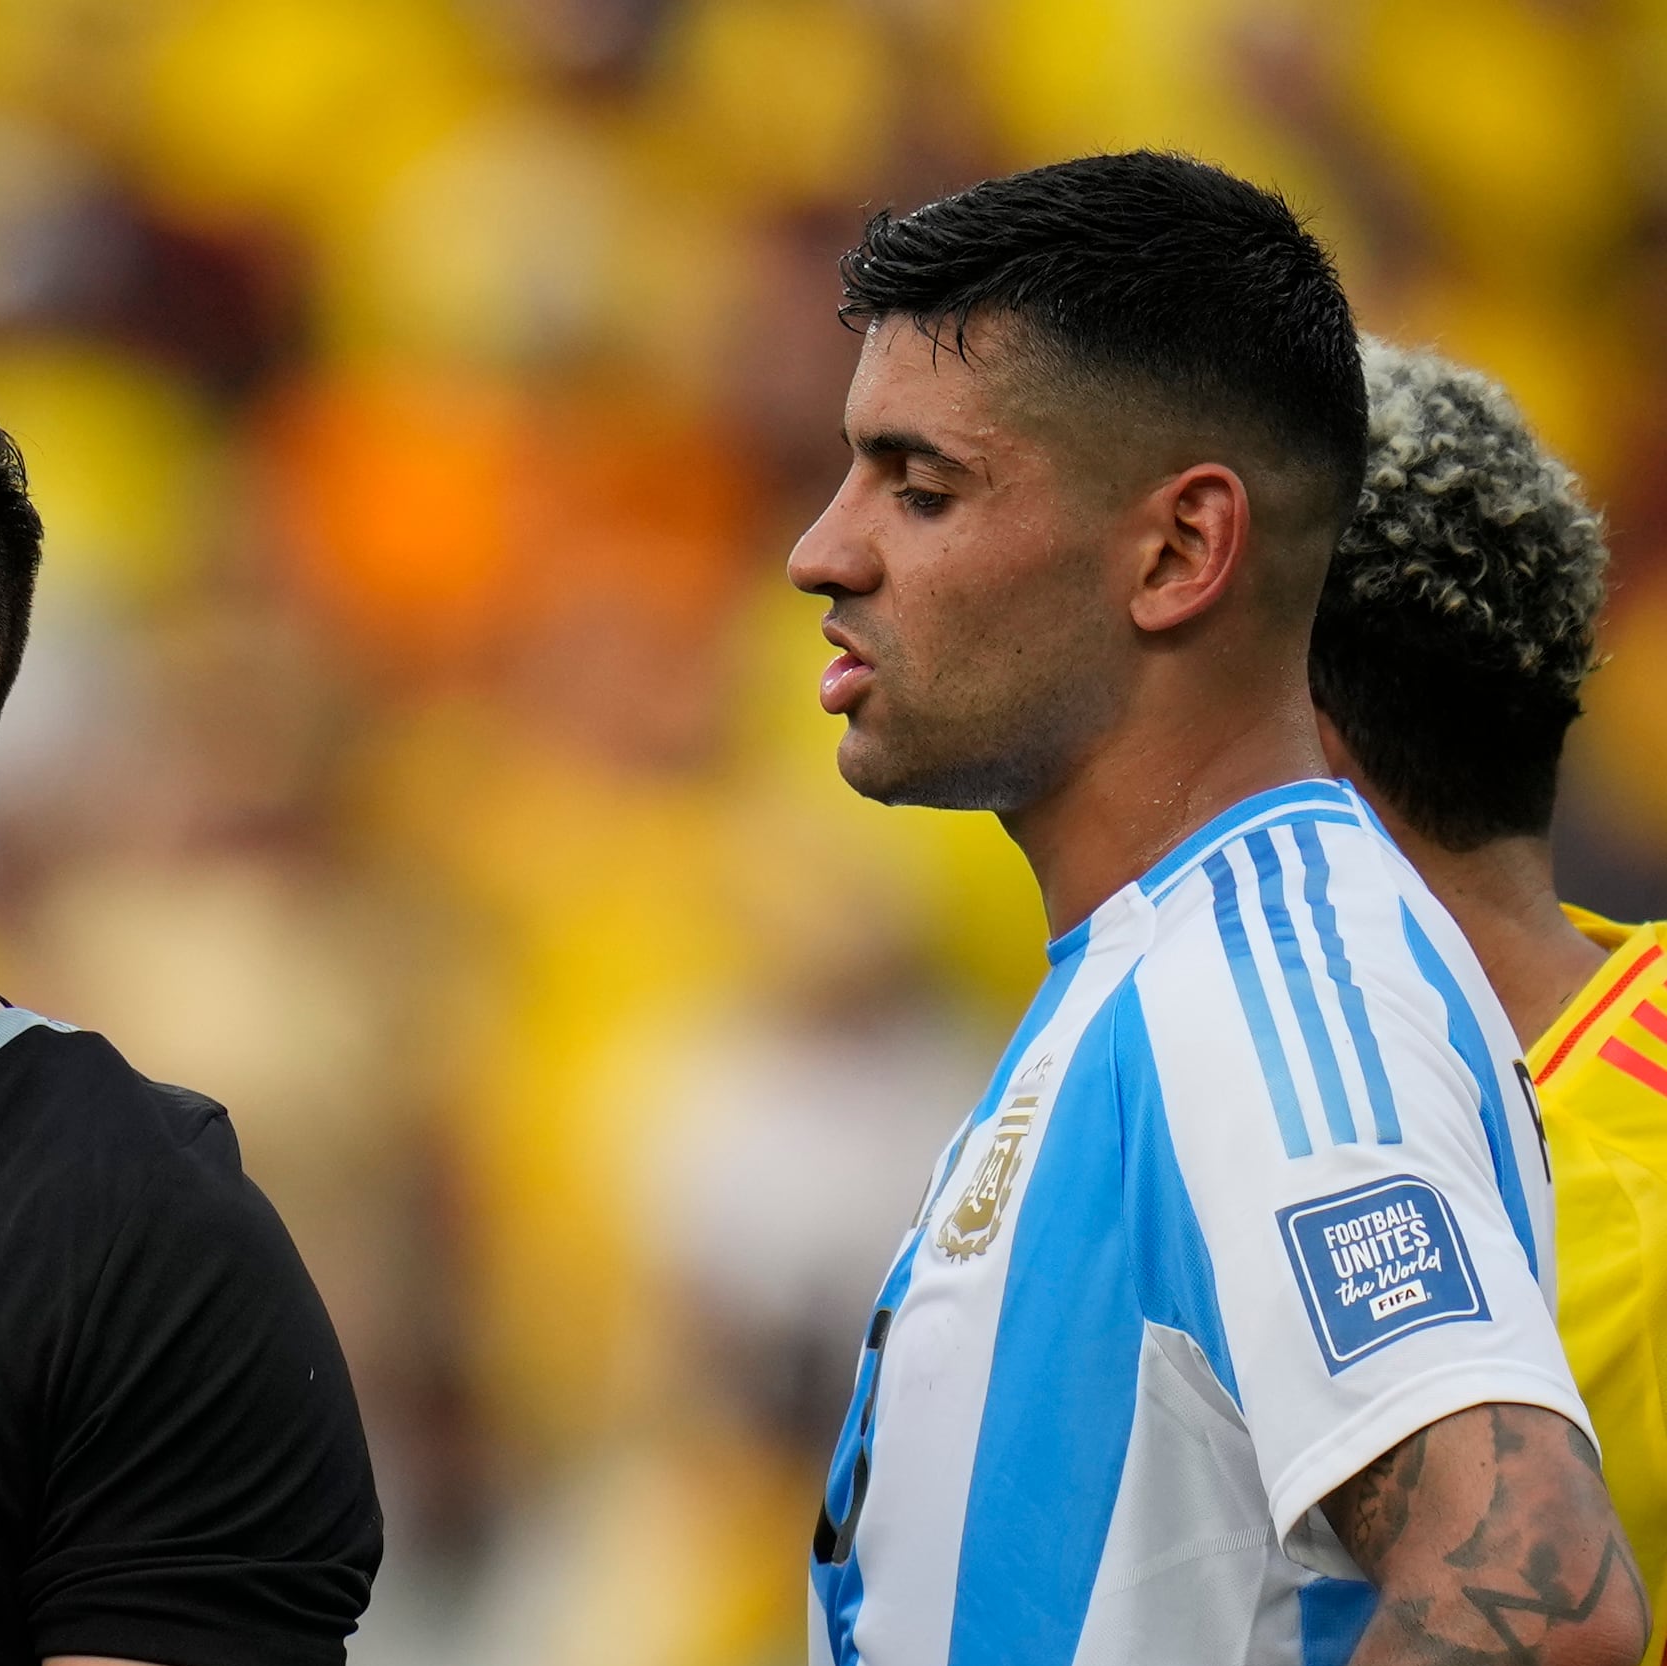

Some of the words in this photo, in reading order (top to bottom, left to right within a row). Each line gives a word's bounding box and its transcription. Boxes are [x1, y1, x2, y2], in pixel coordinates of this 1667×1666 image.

[1323, 1199, 1423, 1249] FOOTBALL
[1330, 1219, 1431, 1279] UNITES
[1334, 1277, 1375, 1306] the
[1375, 1247, 1443, 1289] World
[1378, 1288, 1418, 1311] FIFA
